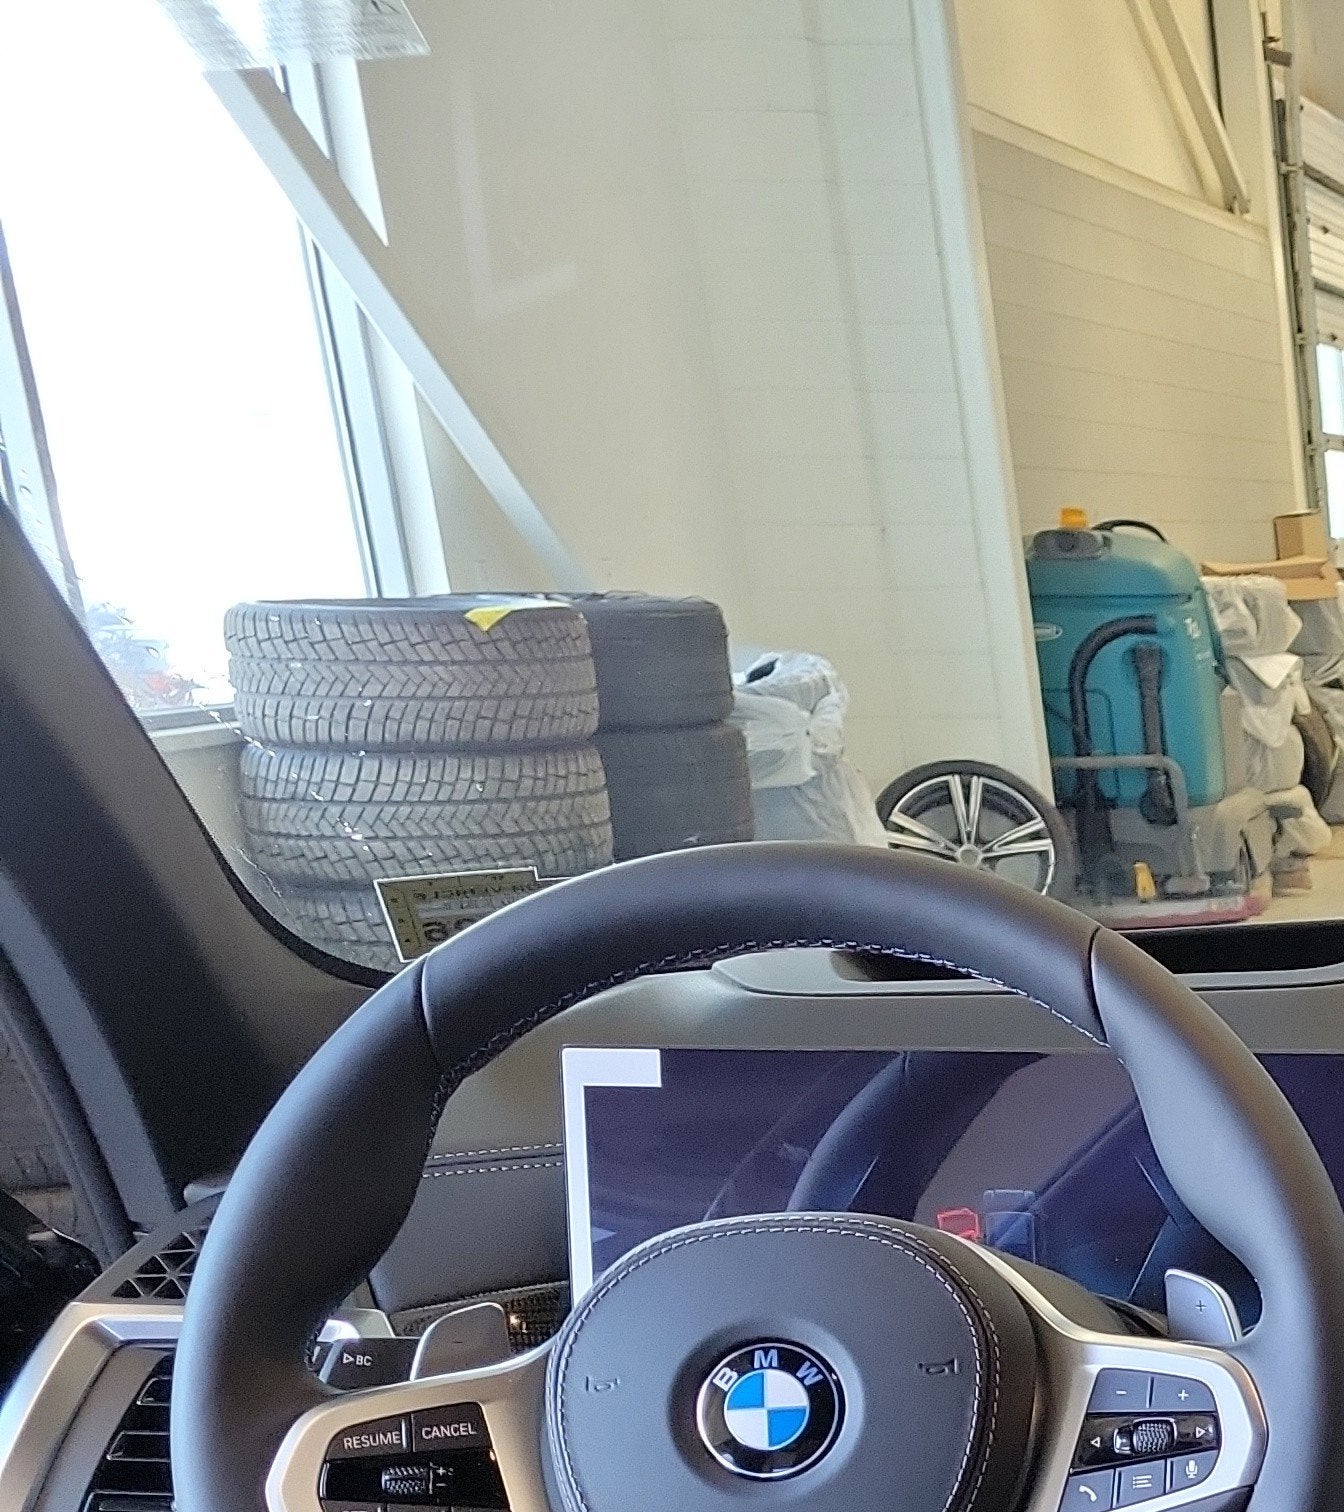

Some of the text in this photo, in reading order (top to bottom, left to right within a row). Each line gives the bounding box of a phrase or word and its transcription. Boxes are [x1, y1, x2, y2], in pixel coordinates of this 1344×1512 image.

[356, 1355, 373, 1367] BC
[712, 1349, 824, 1392] BMW
[421, 1422, 477, 1440] CANCEL
[343, 1431, 401, 1450] RESUME
